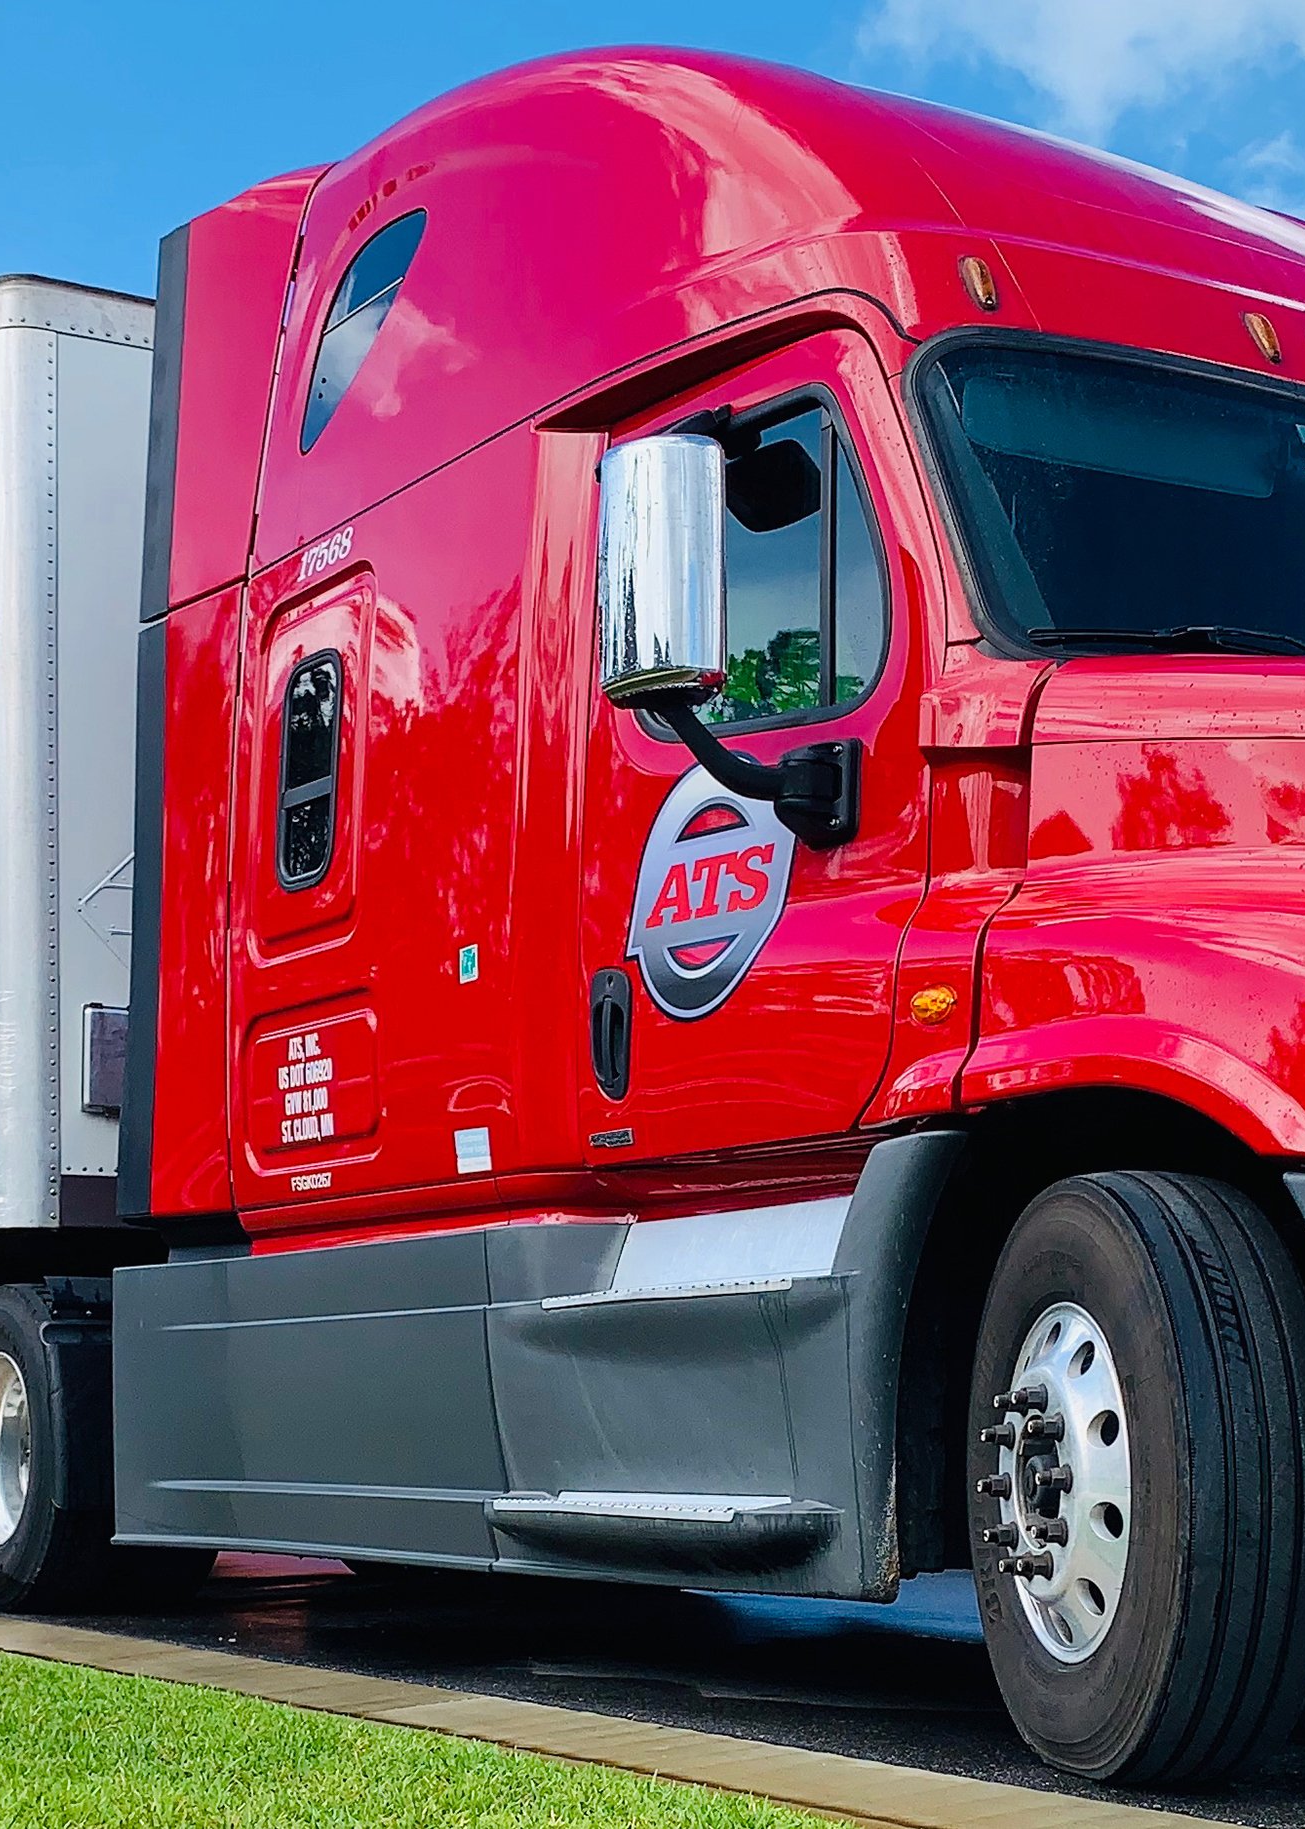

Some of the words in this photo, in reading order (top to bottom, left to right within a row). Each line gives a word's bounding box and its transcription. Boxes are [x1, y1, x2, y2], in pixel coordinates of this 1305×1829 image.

[296, 526, 354, 583] 17568
[645, 843, 776, 929] ATS
[288, 1036, 305, 1062] ATS,
[304, 1032, 321, 1057] INC.
[278, 1066, 289, 1090] US
[289, 1062, 305, 1088] DOT
[281, 1119, 294, 1143] ST.
[294, 1116, 321, 1142] CLOUD,
